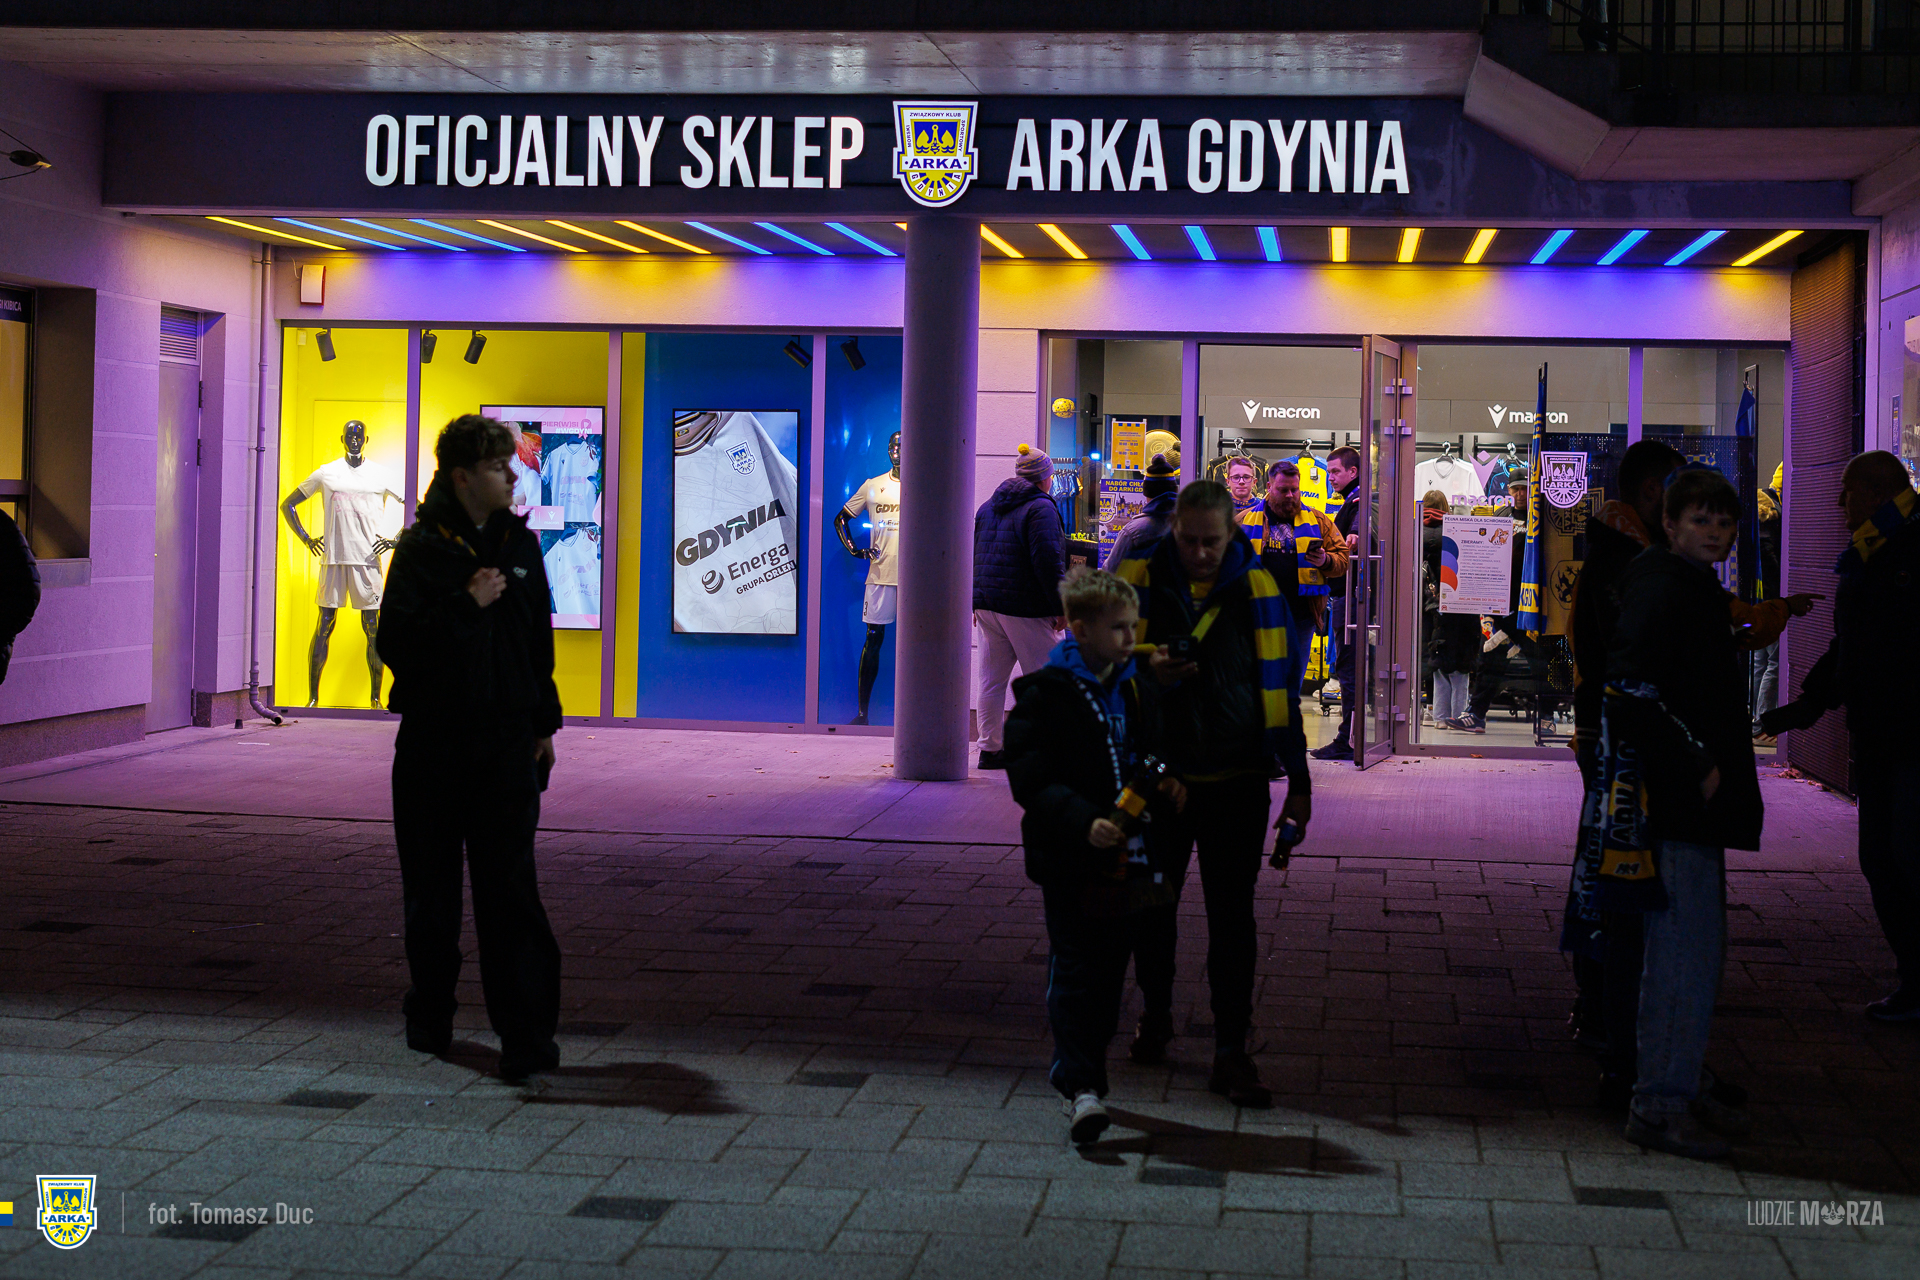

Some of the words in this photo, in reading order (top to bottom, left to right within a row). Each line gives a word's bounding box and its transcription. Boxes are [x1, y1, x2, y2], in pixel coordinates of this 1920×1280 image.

[365, 114, 664, 187] OFICJALNY
[680, 115, 864, 189] SKLEP
[1006, 118, 1168, 192] ARKA
[1187, 118, 1410, 194] GDYNIA
[909, 158, 962, 169] ARKA
[911, 174, 961, 197] GDYNIA
[1262, 406, 1321, 419] macron
[1451, 494, 1515, 508] macron
[676, 498, 787, 567] GDYNIA
[728, 543, 790, 580] Energa
[736, 577, 765, 595] GRUPA
[765, 560, 796, 582] ORLEN
